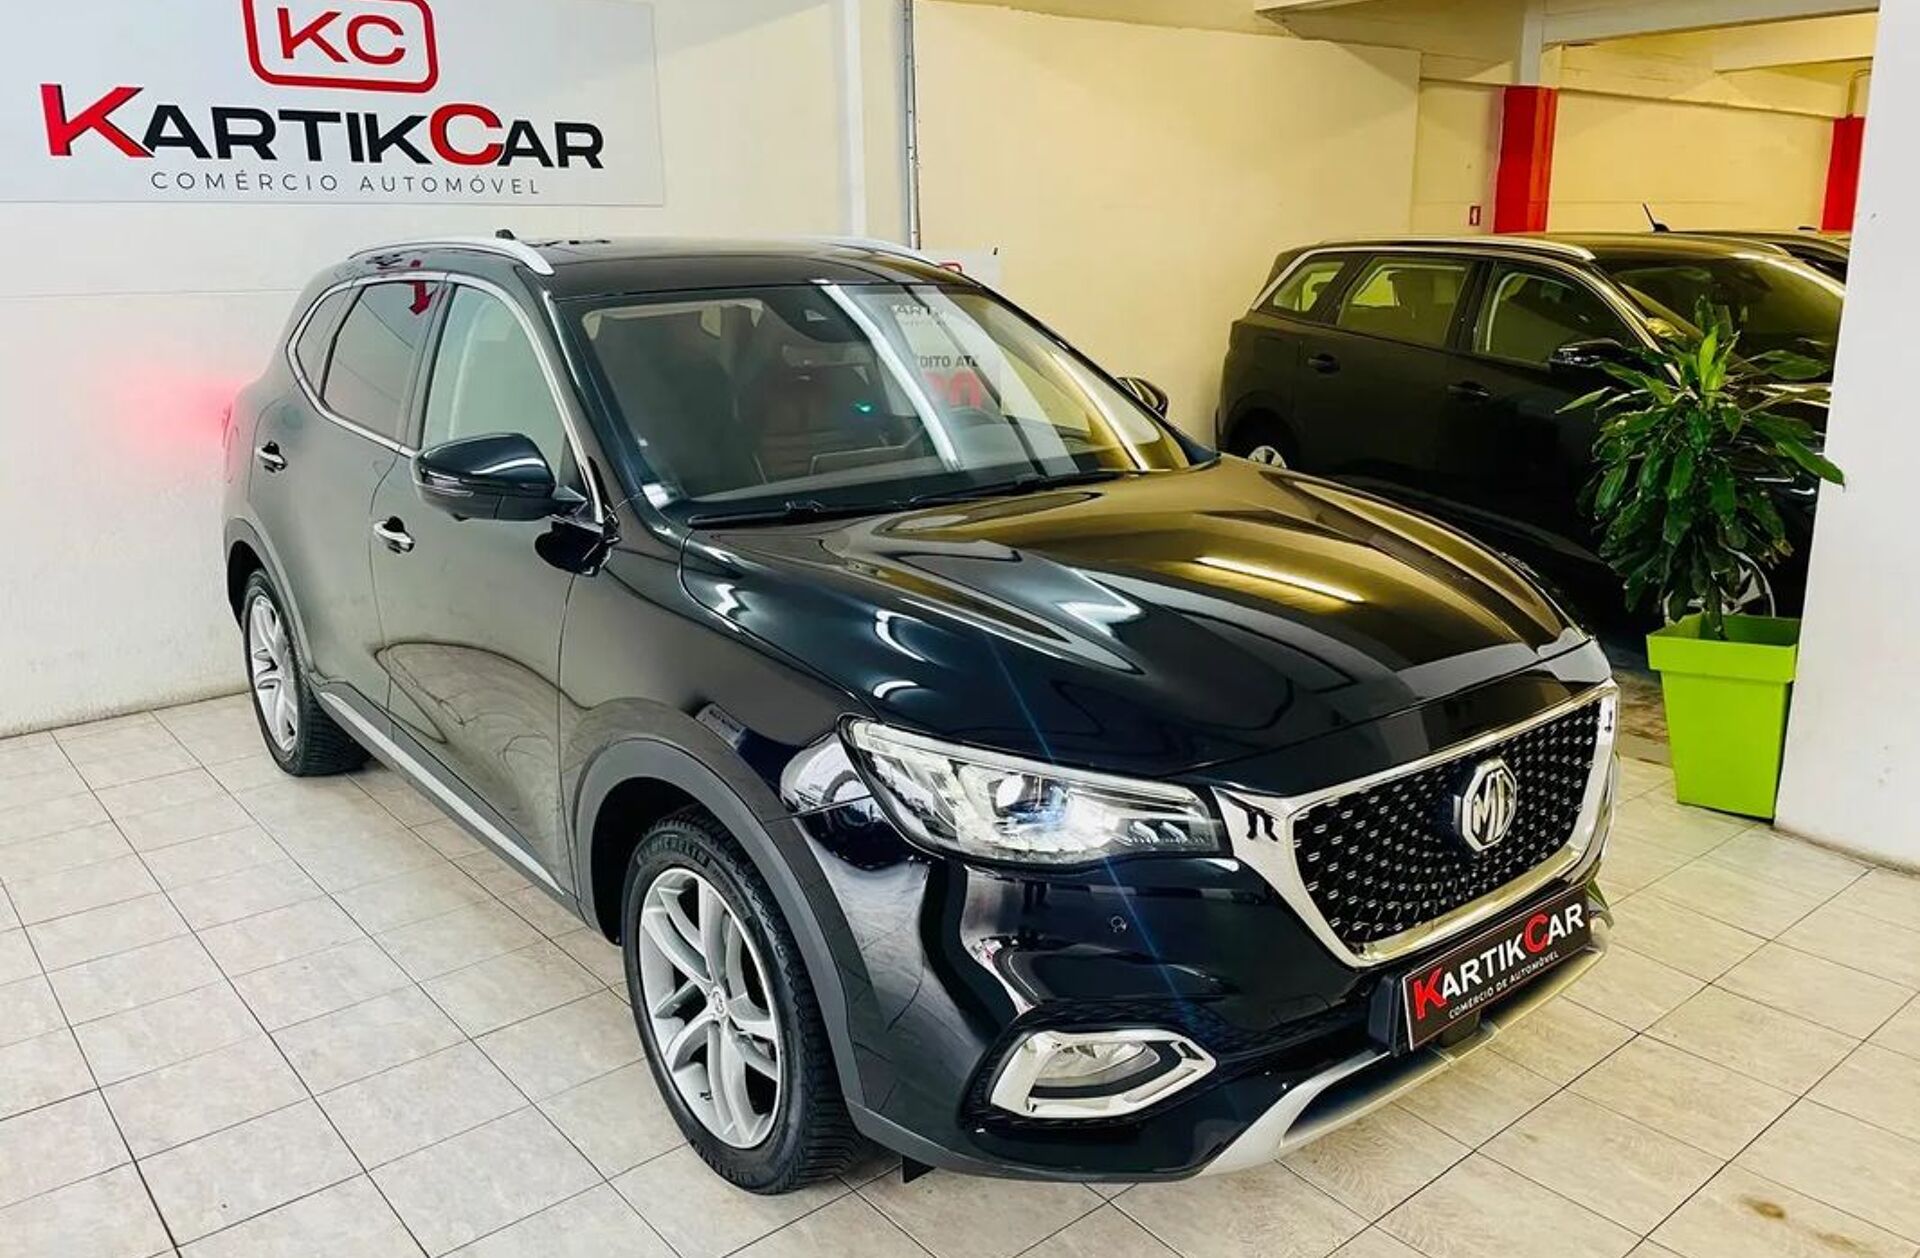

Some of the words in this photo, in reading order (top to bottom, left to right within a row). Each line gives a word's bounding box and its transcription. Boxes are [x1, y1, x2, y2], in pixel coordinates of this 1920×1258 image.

[277, 7, 406, 66] KC
[151, 169, 338, 191] COMÉRCIO
[360, 174, 539, 195] AUTOMÓVEL
[1472, 768, 1516, 842] MG
[1413, 902, 1585, 1020] KARTIKCAR
[1496, 978, 1508, 992] DE
